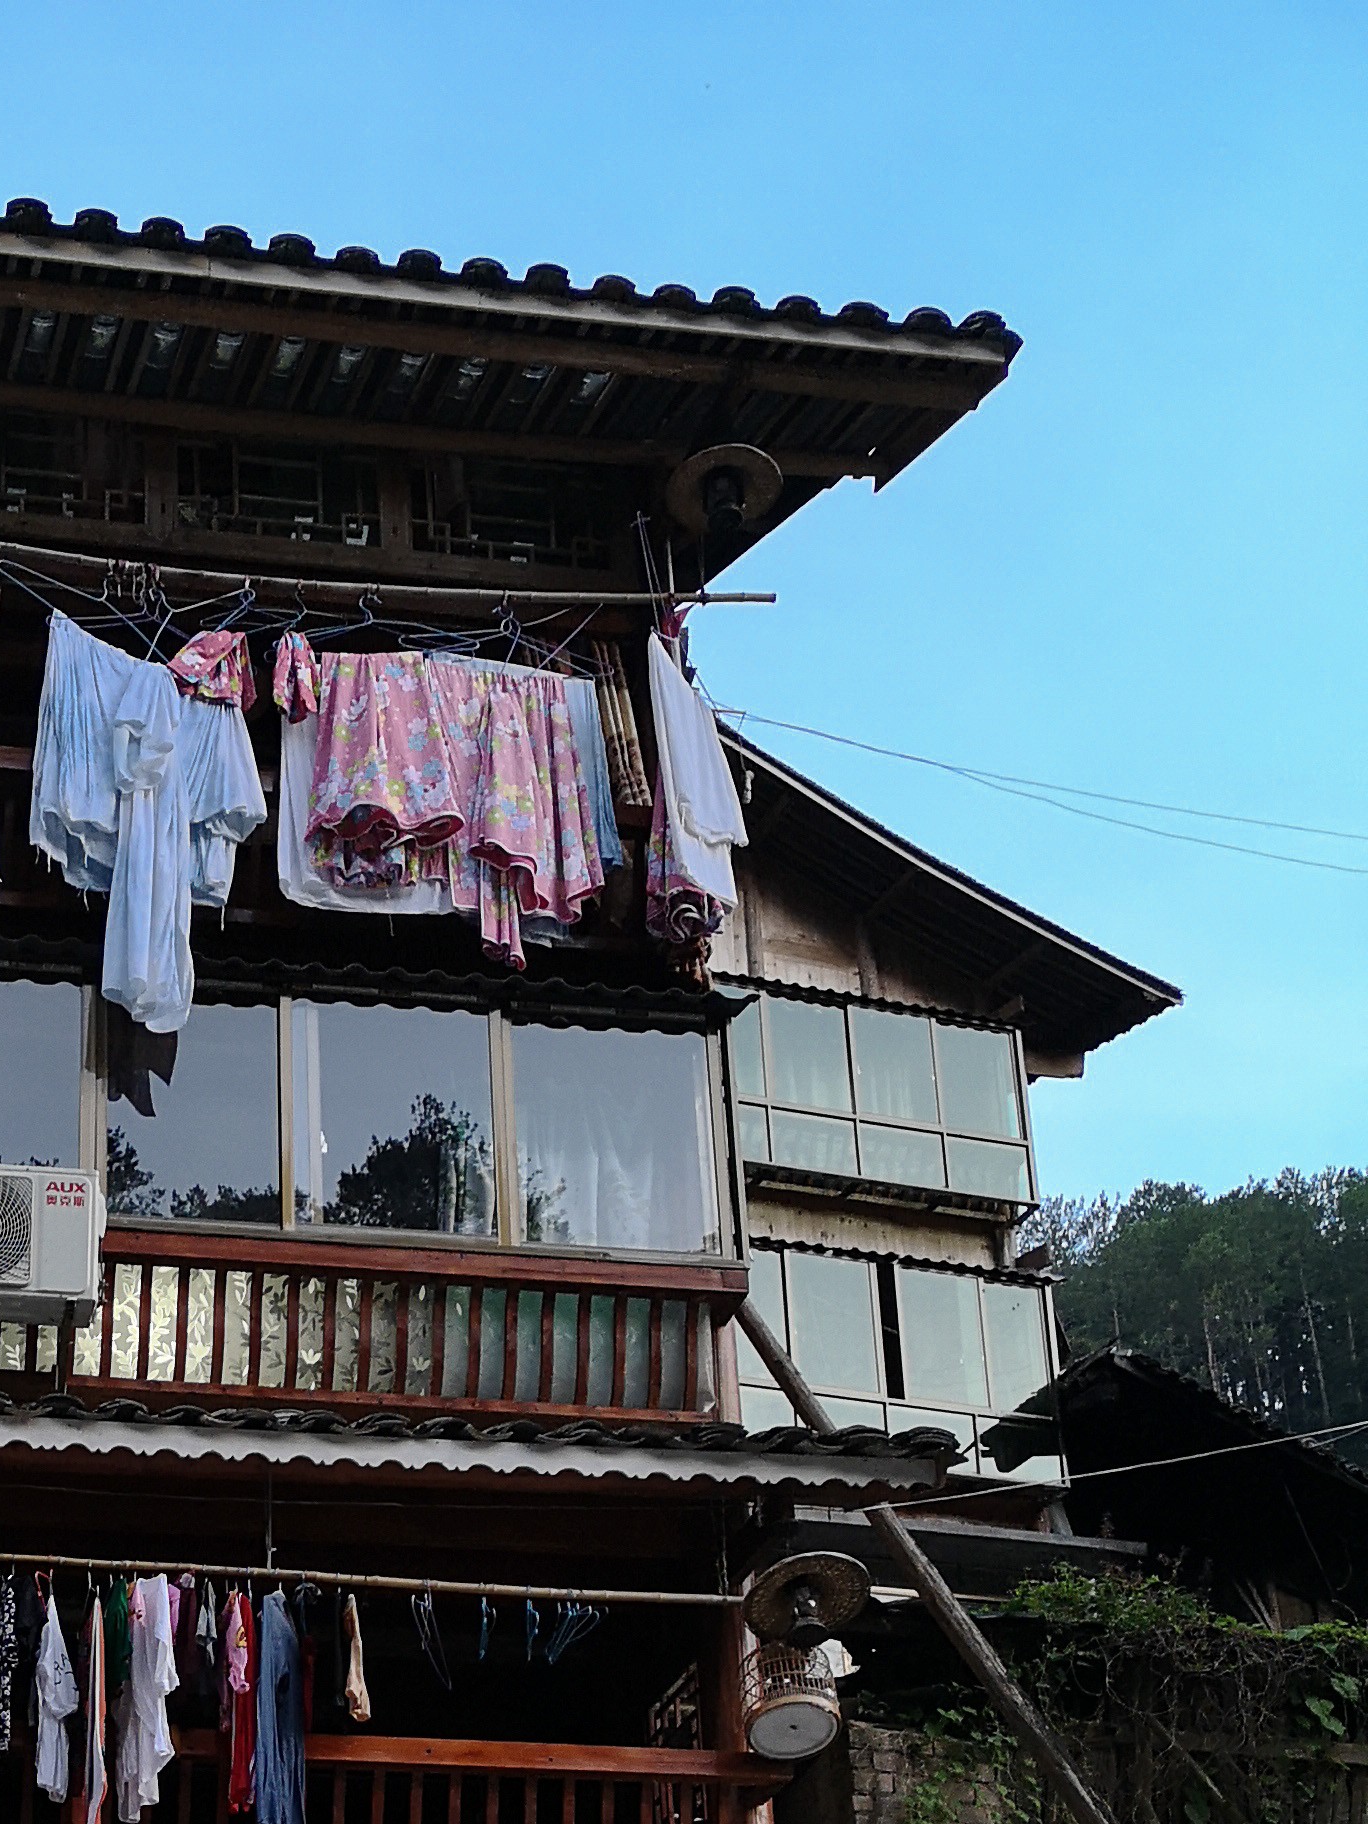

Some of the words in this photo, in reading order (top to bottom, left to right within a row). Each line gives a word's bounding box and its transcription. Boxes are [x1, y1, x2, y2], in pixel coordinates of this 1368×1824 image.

[45, 1181, 86, 1194] AUX
[46, 1194, 85, 1207] 奥克斯
